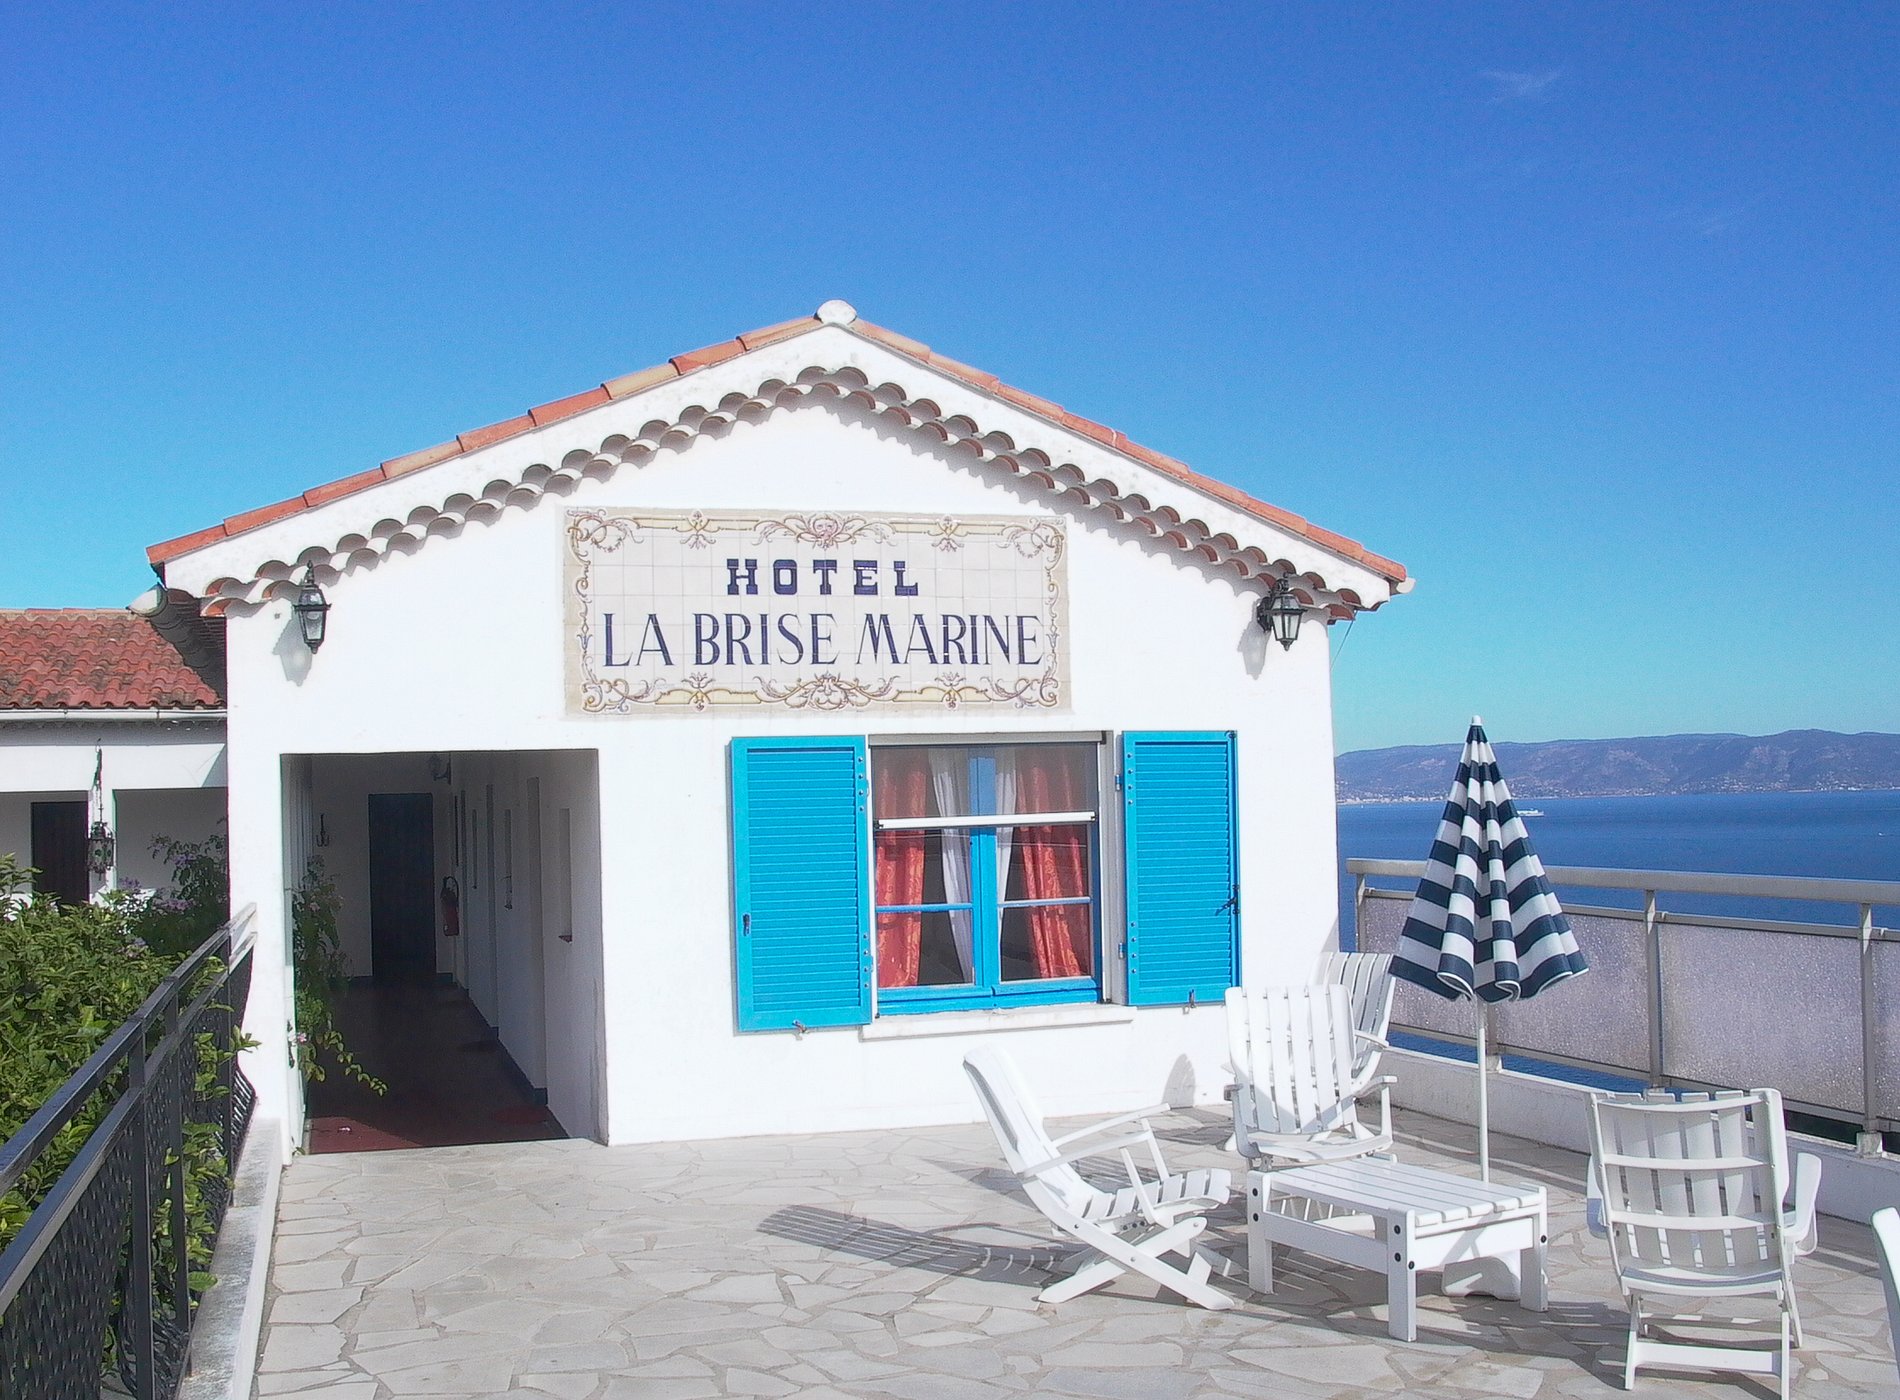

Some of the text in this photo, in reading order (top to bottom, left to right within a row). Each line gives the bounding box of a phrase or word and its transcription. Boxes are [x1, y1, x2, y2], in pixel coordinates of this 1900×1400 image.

[726, 558, 919, 596] HOTEL
[602, 613, 1045, 667] LA BRISE MARINE
